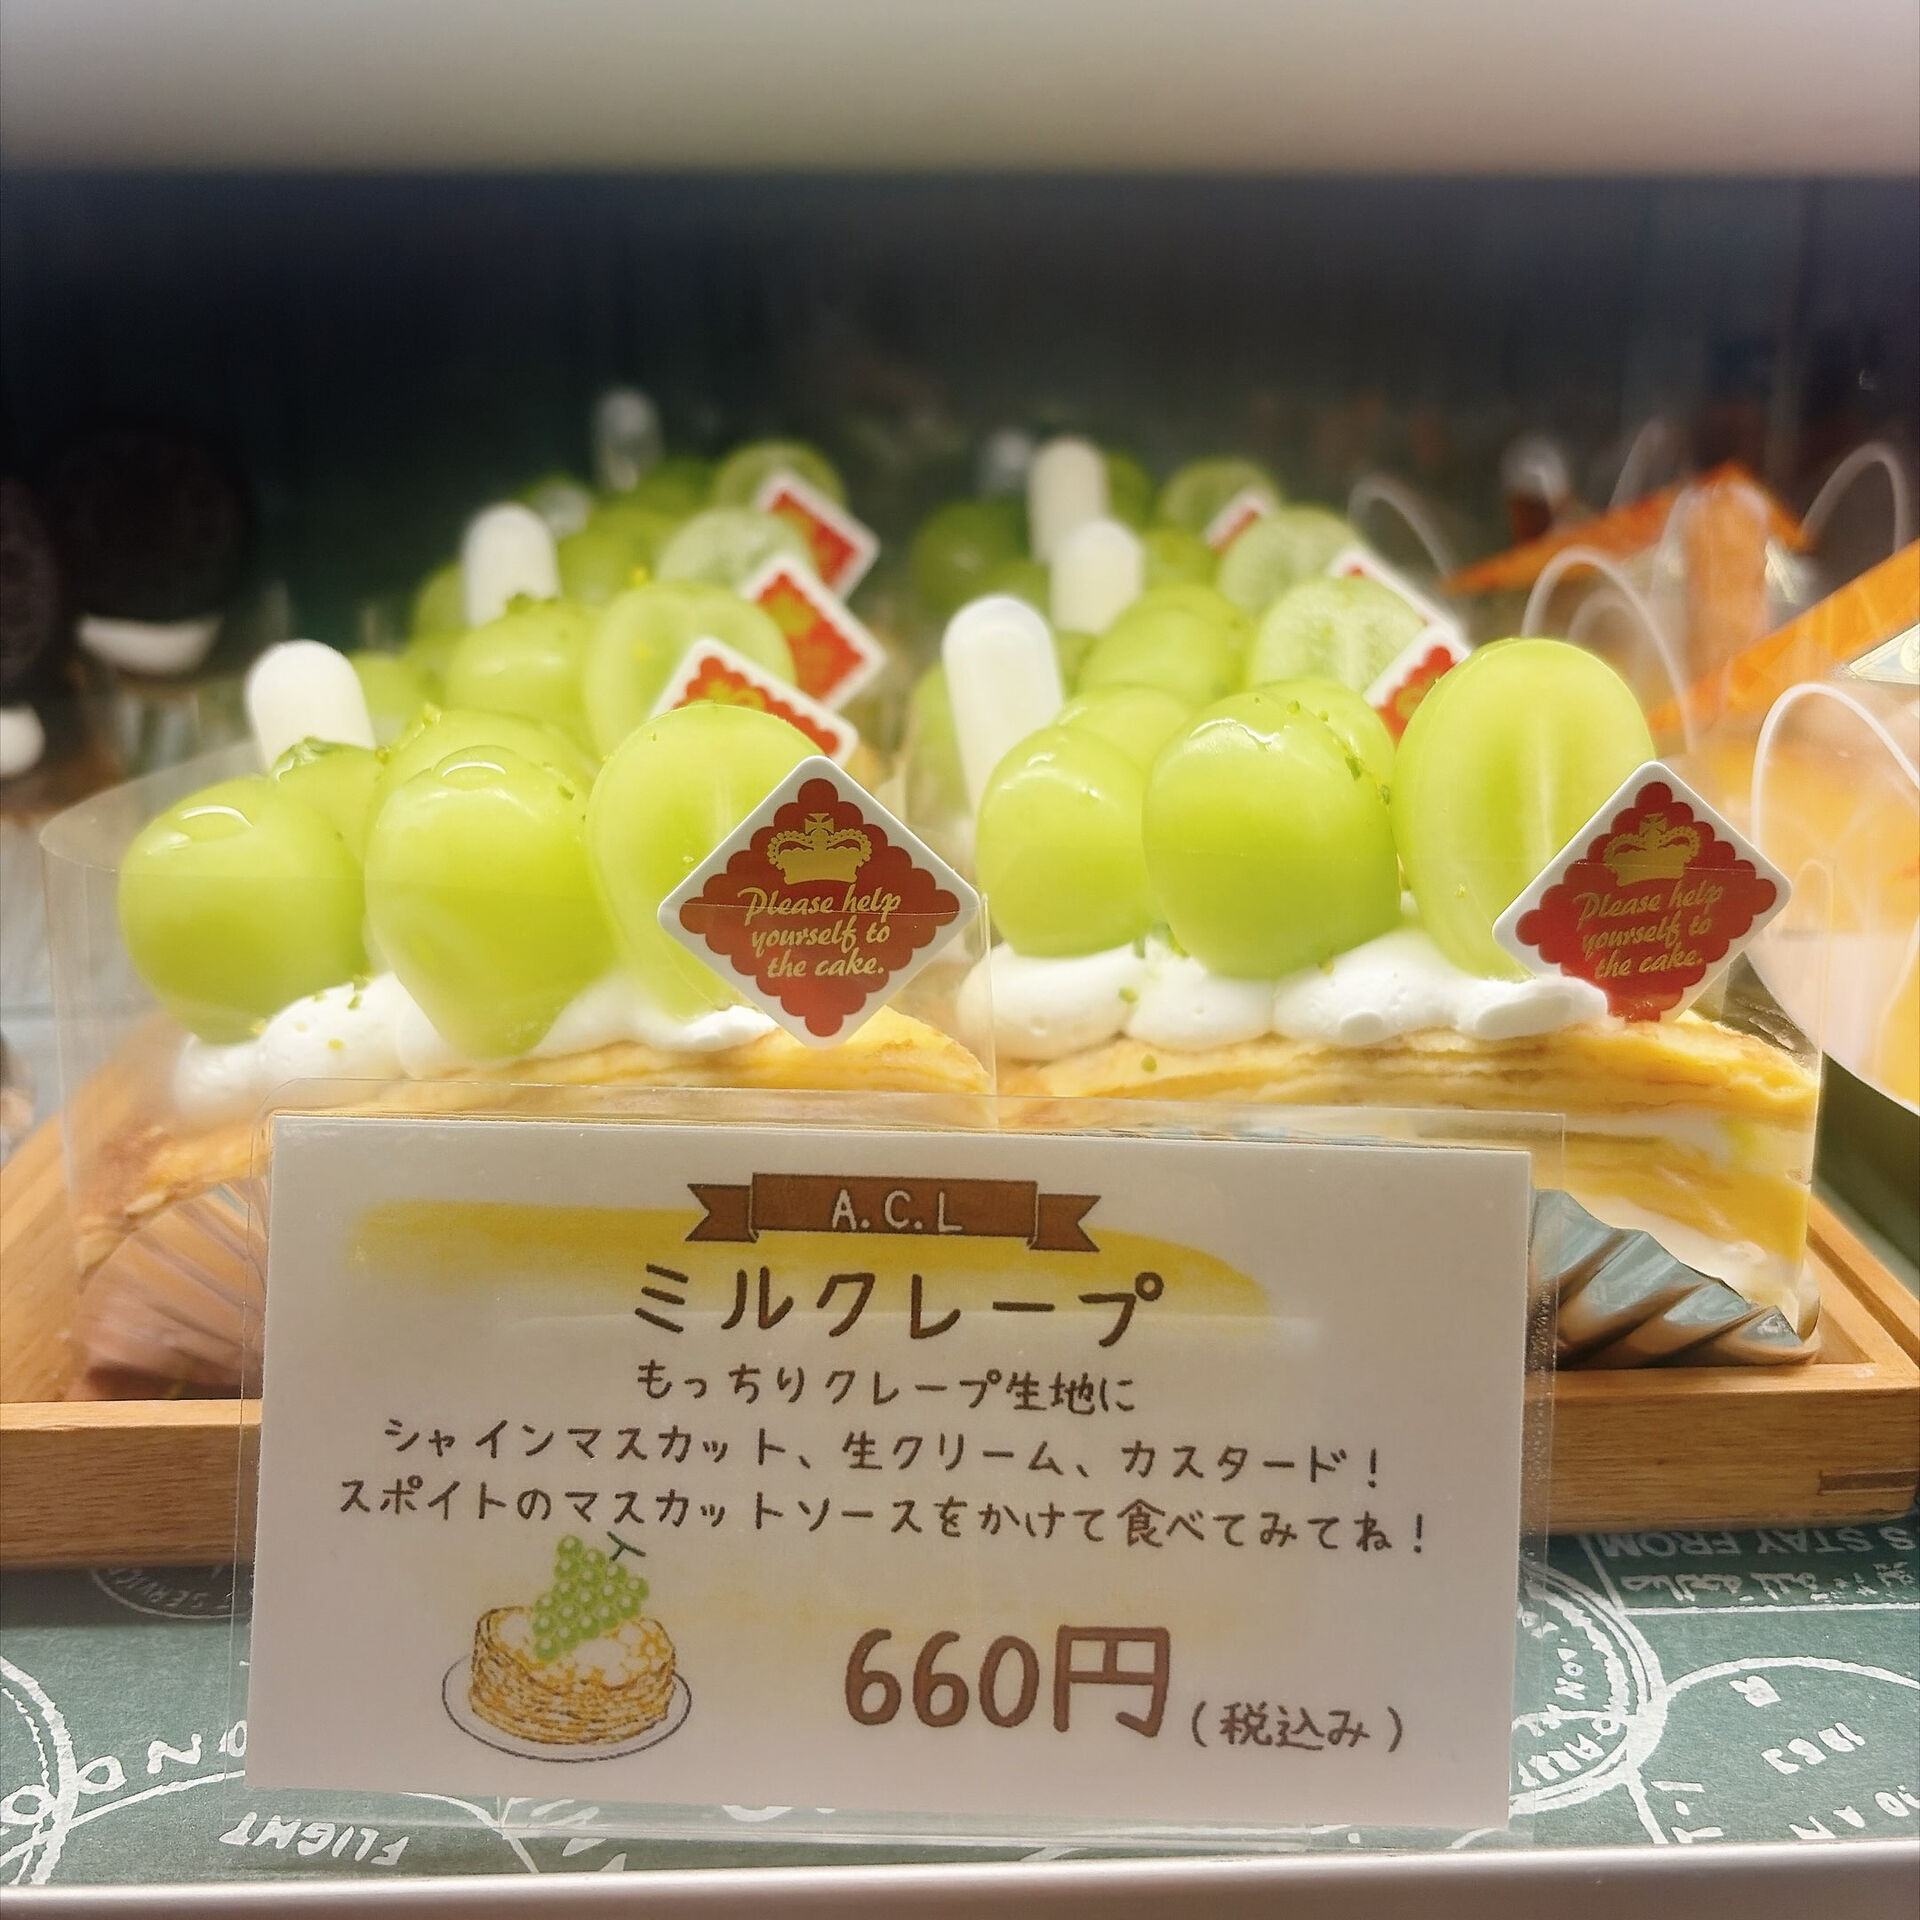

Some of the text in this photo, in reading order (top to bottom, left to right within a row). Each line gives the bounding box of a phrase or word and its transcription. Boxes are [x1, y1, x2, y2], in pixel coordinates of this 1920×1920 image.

[737, 883, 901, 926] Please help
[1574, 880, 1723, 930] Please help
[752, 914, 890, 957] yourself to
[1582, 910, 1713, 960] yourself to
[767, 949, 884, 978] the cake.
[1594, 946, 1703, 979] the cake.
[832, 1189, 963, 1234] A.C.L
[635, 1264, 1164, 1348] ミルクレープ
[638, 1359, 1136, 1415] もっちりクレープ生地に
[1601, 1529, 1742, 1559] FROM
[1755, 1526, 1874, 1556] STAY
[845, 1625, 1171, 1738] 660円
[218, 1811, 410, 1867] FLIGHT
